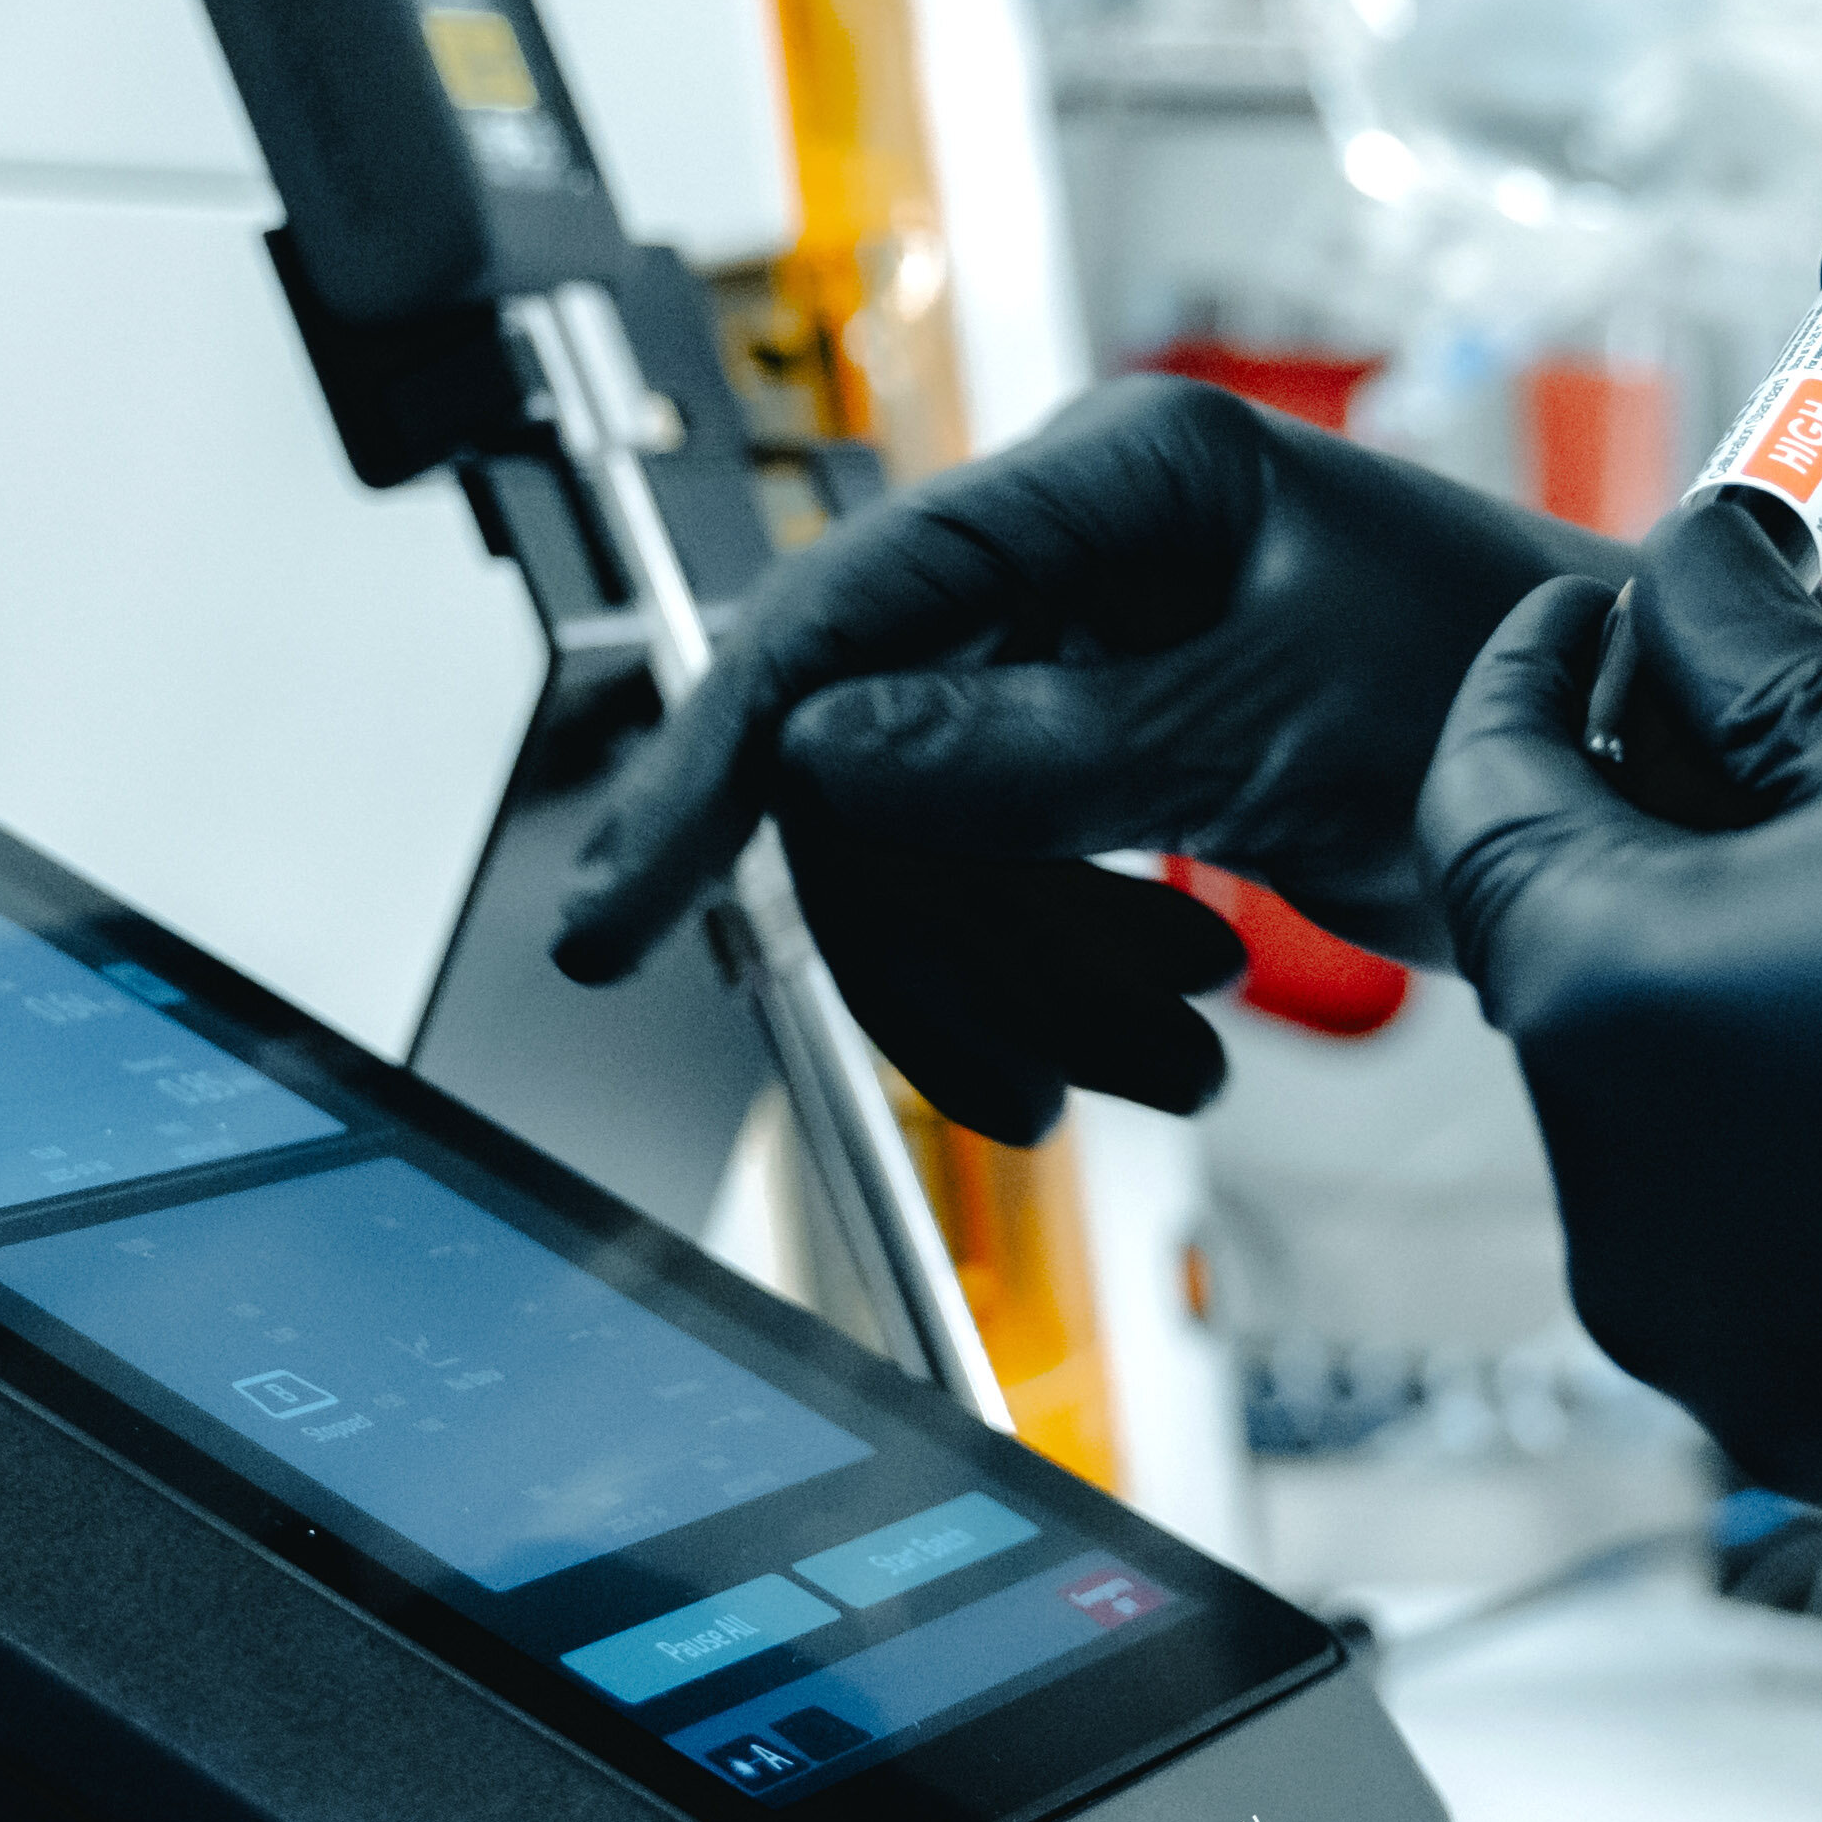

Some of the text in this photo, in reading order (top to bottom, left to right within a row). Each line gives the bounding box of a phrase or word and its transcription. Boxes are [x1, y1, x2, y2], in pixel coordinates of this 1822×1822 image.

[262, 1382, 300, 1403] B
[654, 1612, 762, 1663] Pause All
